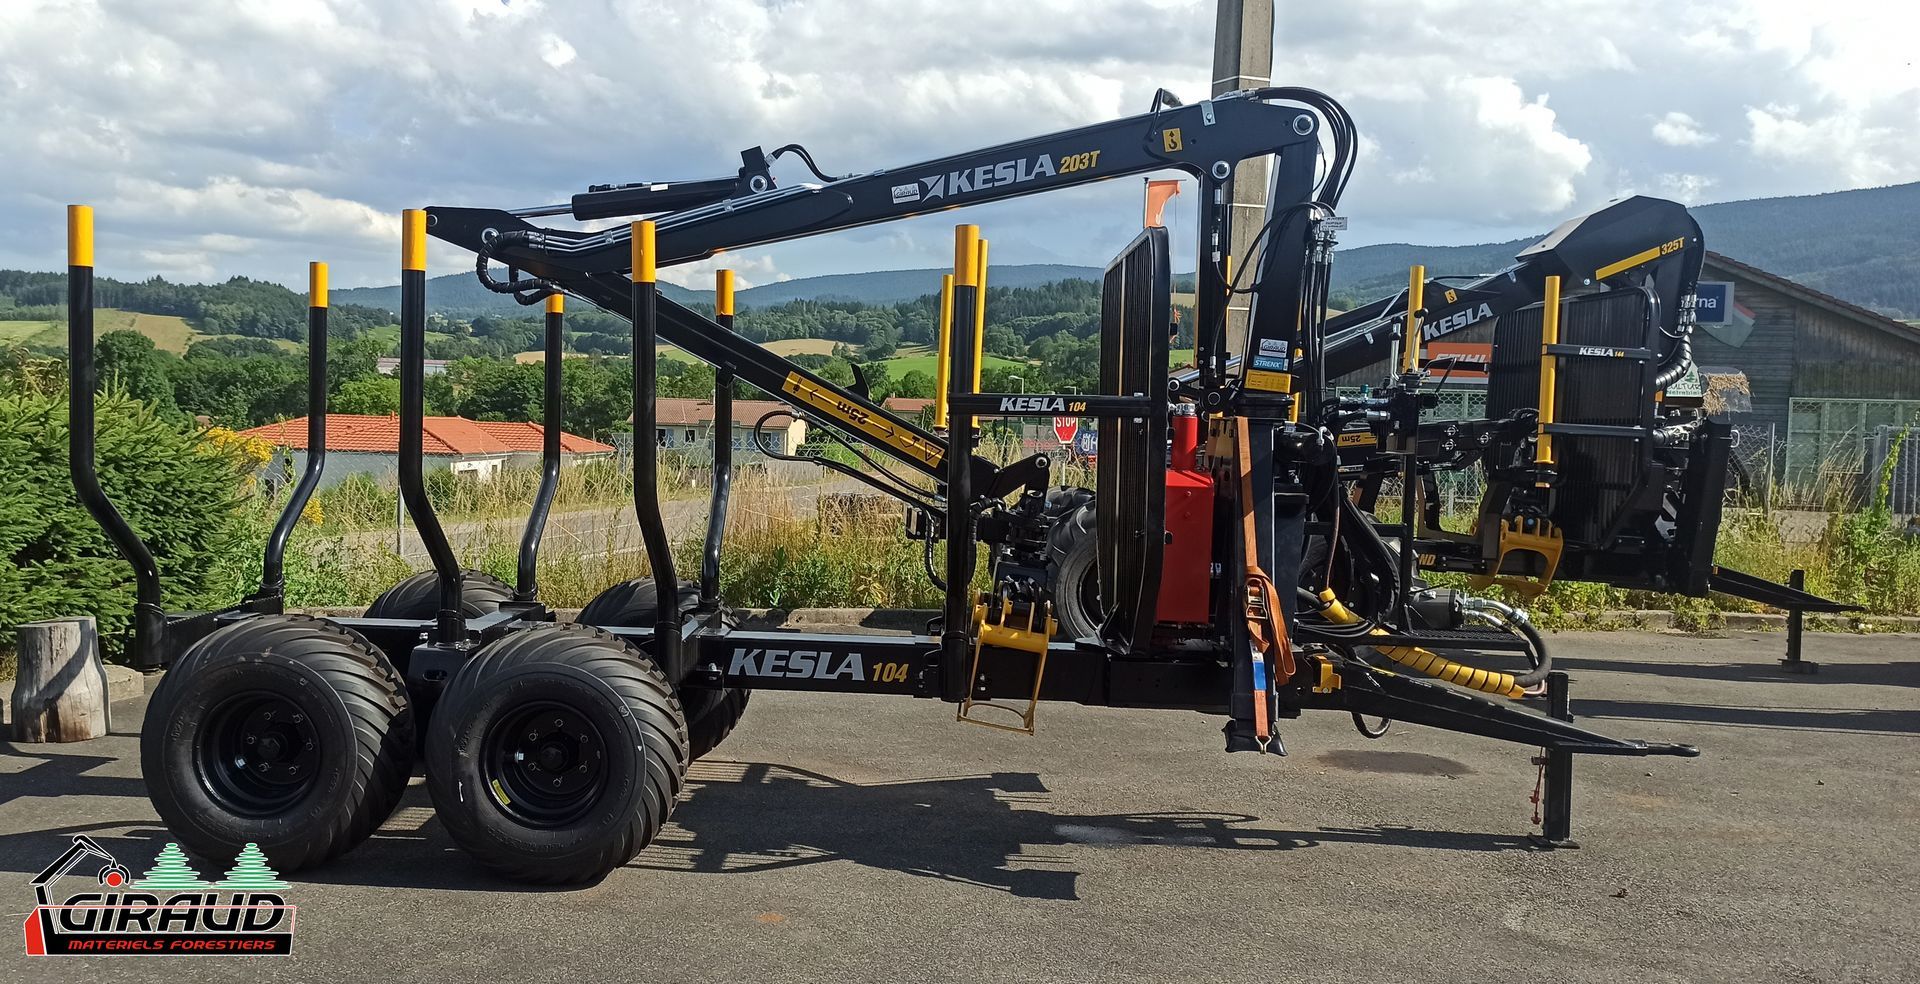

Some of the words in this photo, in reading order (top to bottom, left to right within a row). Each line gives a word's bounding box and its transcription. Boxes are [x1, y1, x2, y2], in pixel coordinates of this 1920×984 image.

[948, 153, 1057, 196] KESLA
[1059, 149, 1101, 175] 203T
[1661, 236, 1685, 256] 325T
[1697, 297, 1718, 309] na
[1423, 302, 1494, 341] KESLA
[1578, 347, 1614, 358] KESLA
[1254, 360, 1282, 369] STRENX
[1000, 397, 1066, 412] KESLA
[1068, 401, 1087, 412] 104
[836, 401, 870, 425] 25m
[1056, 417, 1077, 428] STOP
[1341, 434, 1361, 443] 25m
[1417, 553, 1437, 566] ND
[728, 648, 866, 682] KESLA
[872, 661, 910, 683] 104
